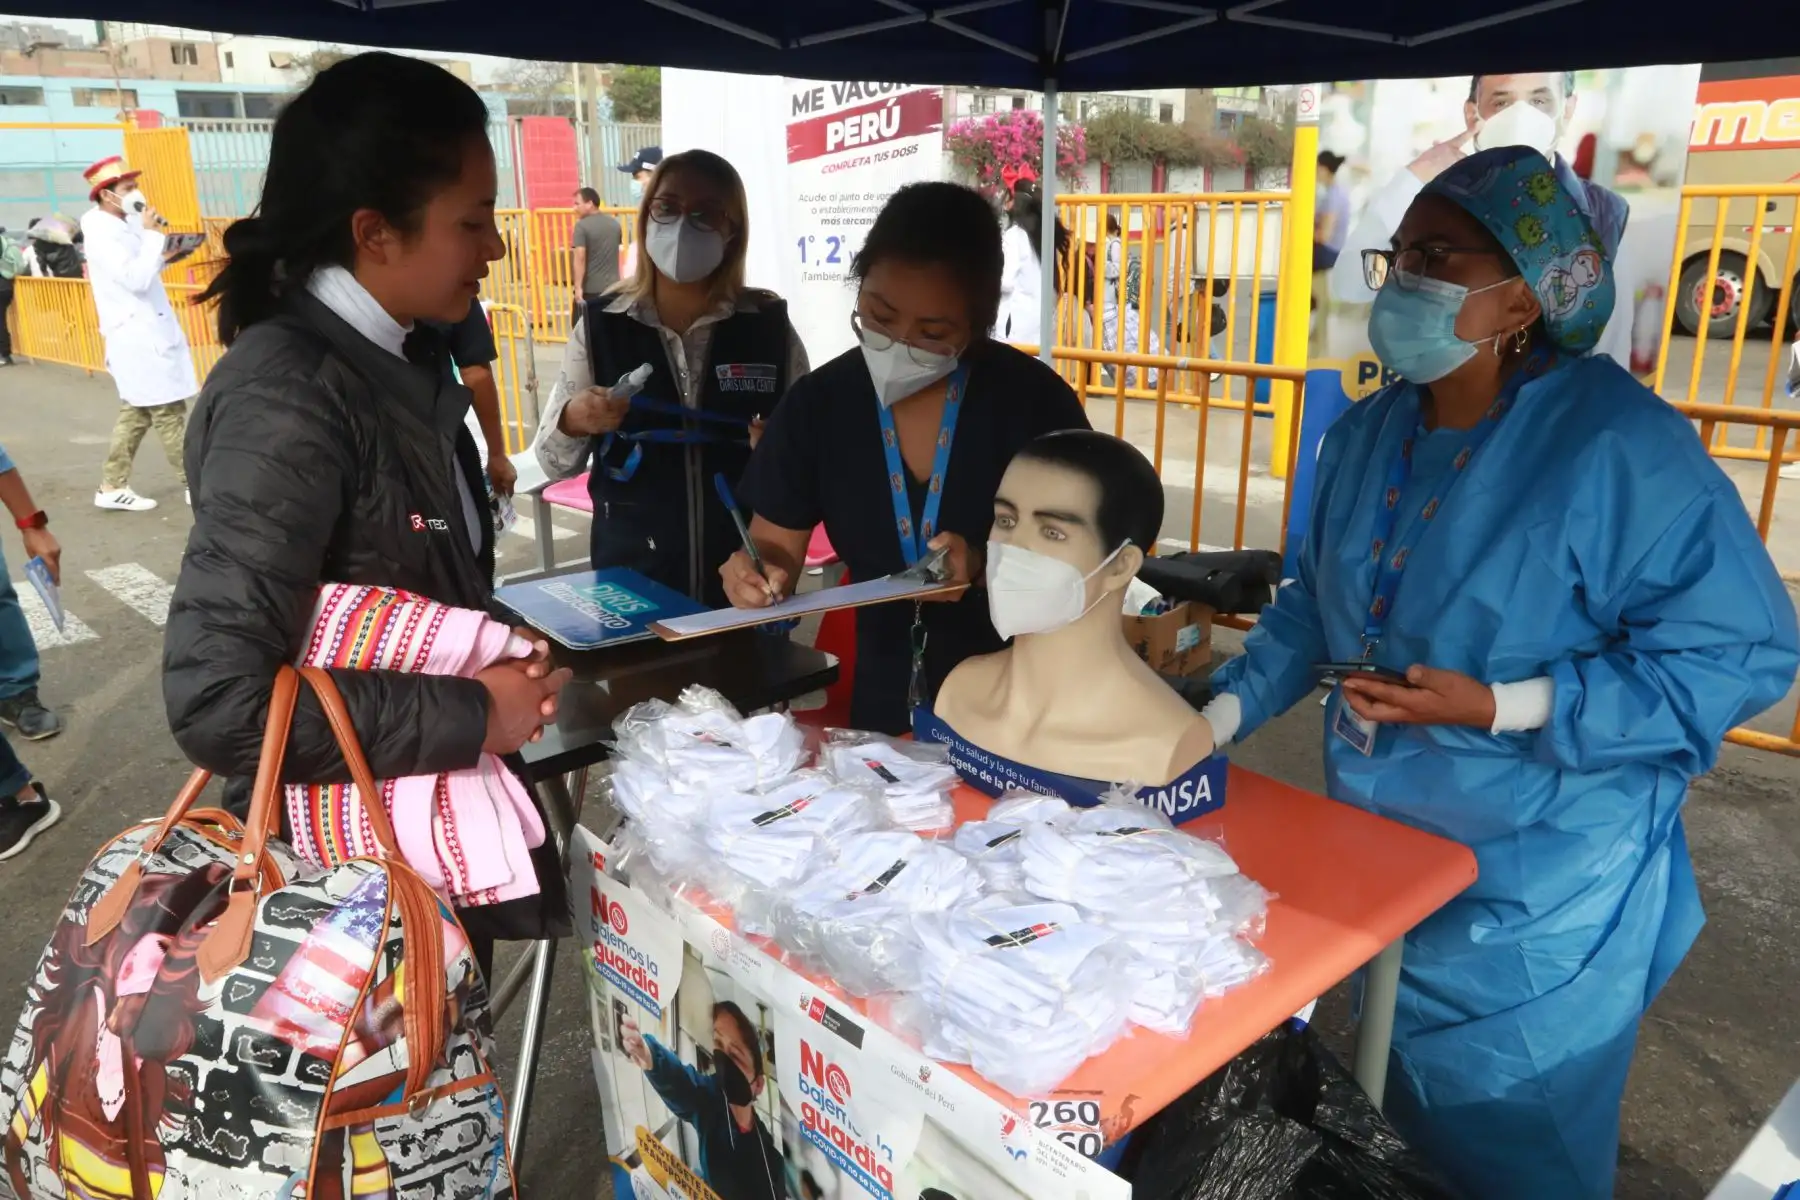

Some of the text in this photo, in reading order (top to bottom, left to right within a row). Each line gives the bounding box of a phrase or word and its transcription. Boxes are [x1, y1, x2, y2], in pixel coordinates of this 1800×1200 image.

[792, 87, 825, 116] ME
[826, 97, 901, 152] PERÚ
[821, 143, 919, 174] COMPLETA TUS DOSIS
[798, 191, 827, 203] Acude
[863, 191, 875, 202] de
[811, 207, 818, 216] o
[821, 214, 841, 226] más
[582, 584, 649, 613] DIRIS
[931, 728, 955, 747] Cuida
[955, 740, 965, 752] tu
[965, 747, 988, 765] salud
[990, 759, 996, 770] y
[996, 760, 1005, 774] la
[1005, 767, 1018, 780] de
[1019, 773, 1029, 786] tu
[979, 770, 993, 784] de
[994, 775, 1004, 790] la
[590, 884, 629, 936] NO
[590, 914, 659, 978] bajemos la
[593, 939, 660, 1002] guardia
[800, 1038, 852, 1105] NO
[890, 1064, 955, 1112] Gobierno del Perú
[1029, 1101, 1100, 1129] 260
[800, 1101, 894, 1193] guardia
[801, 1124, 812, 1139] La
[812, 1134, 847, 1169] COVID-19
[847, 1165, 859, 1179] no
[859, 1174, 870, 1187] se
[869, 1181, 881, 1197] ha
[1038, 1139, 1087, 1173] BICENTENARIO
[1056, 1132, 1102, 1159] 60
